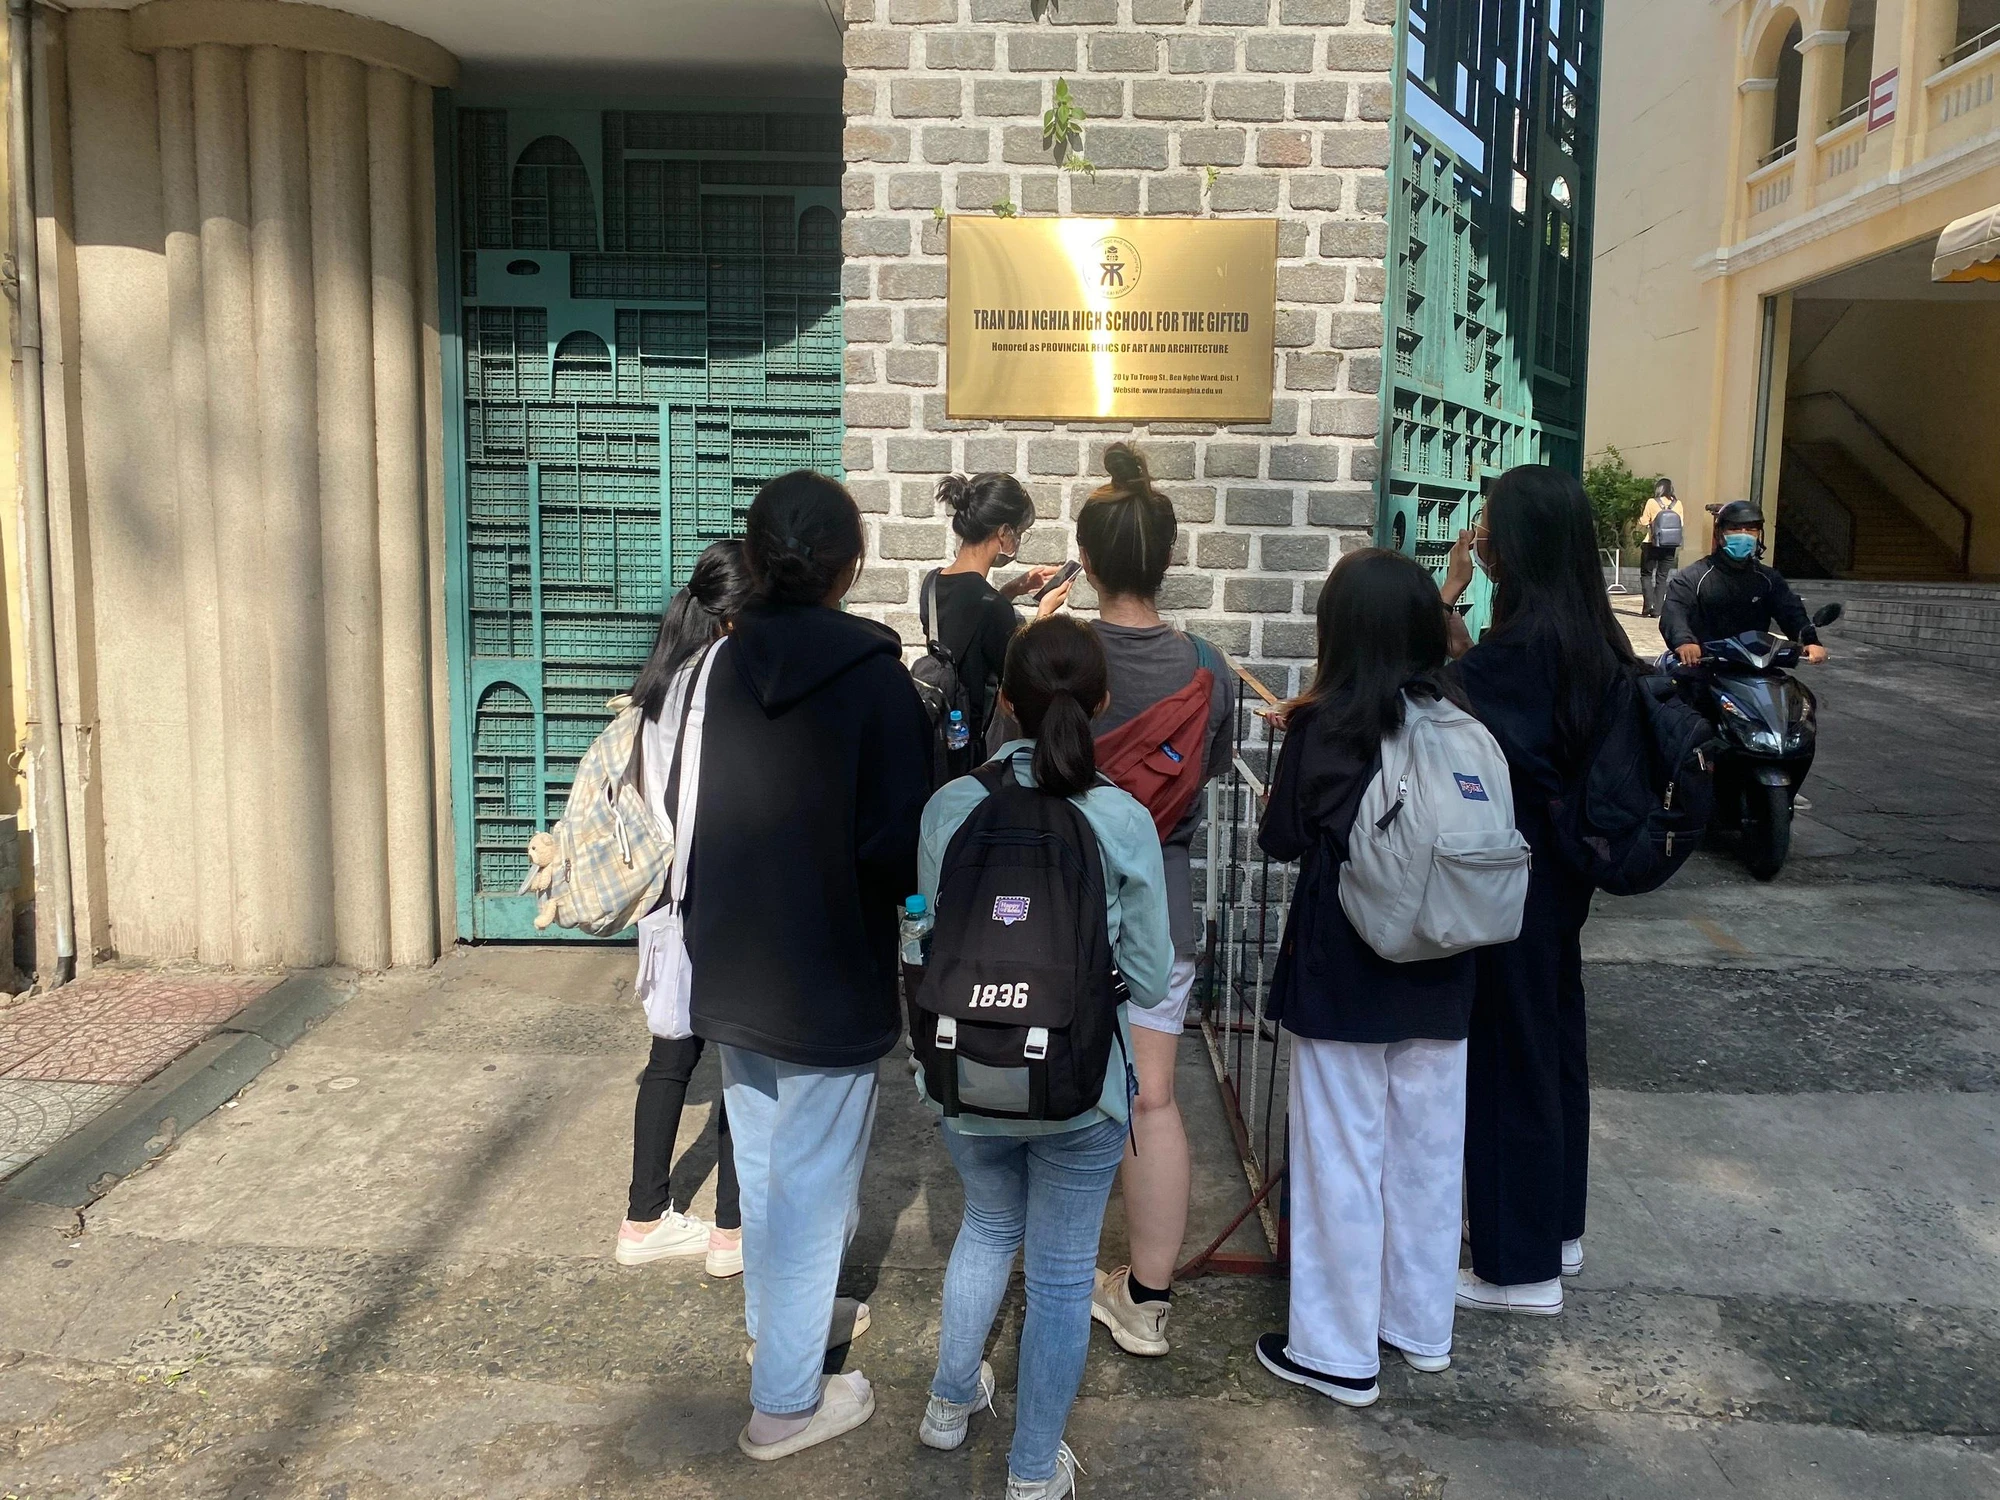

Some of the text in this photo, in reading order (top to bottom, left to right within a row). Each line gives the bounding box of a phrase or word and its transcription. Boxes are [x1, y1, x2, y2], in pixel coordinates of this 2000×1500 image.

[974, 309, 1249, 333] TRAN DAI NGHIA HIGH SCHOOL FOR THE GIFTED
[992, 342, 1229, 354] Honored as PROVINCIAL RELICS OF ART AND ARCHITECTURE
[1139, 373, 1158, 381] Trong
[968, 982, 1029, 1009] 1836
